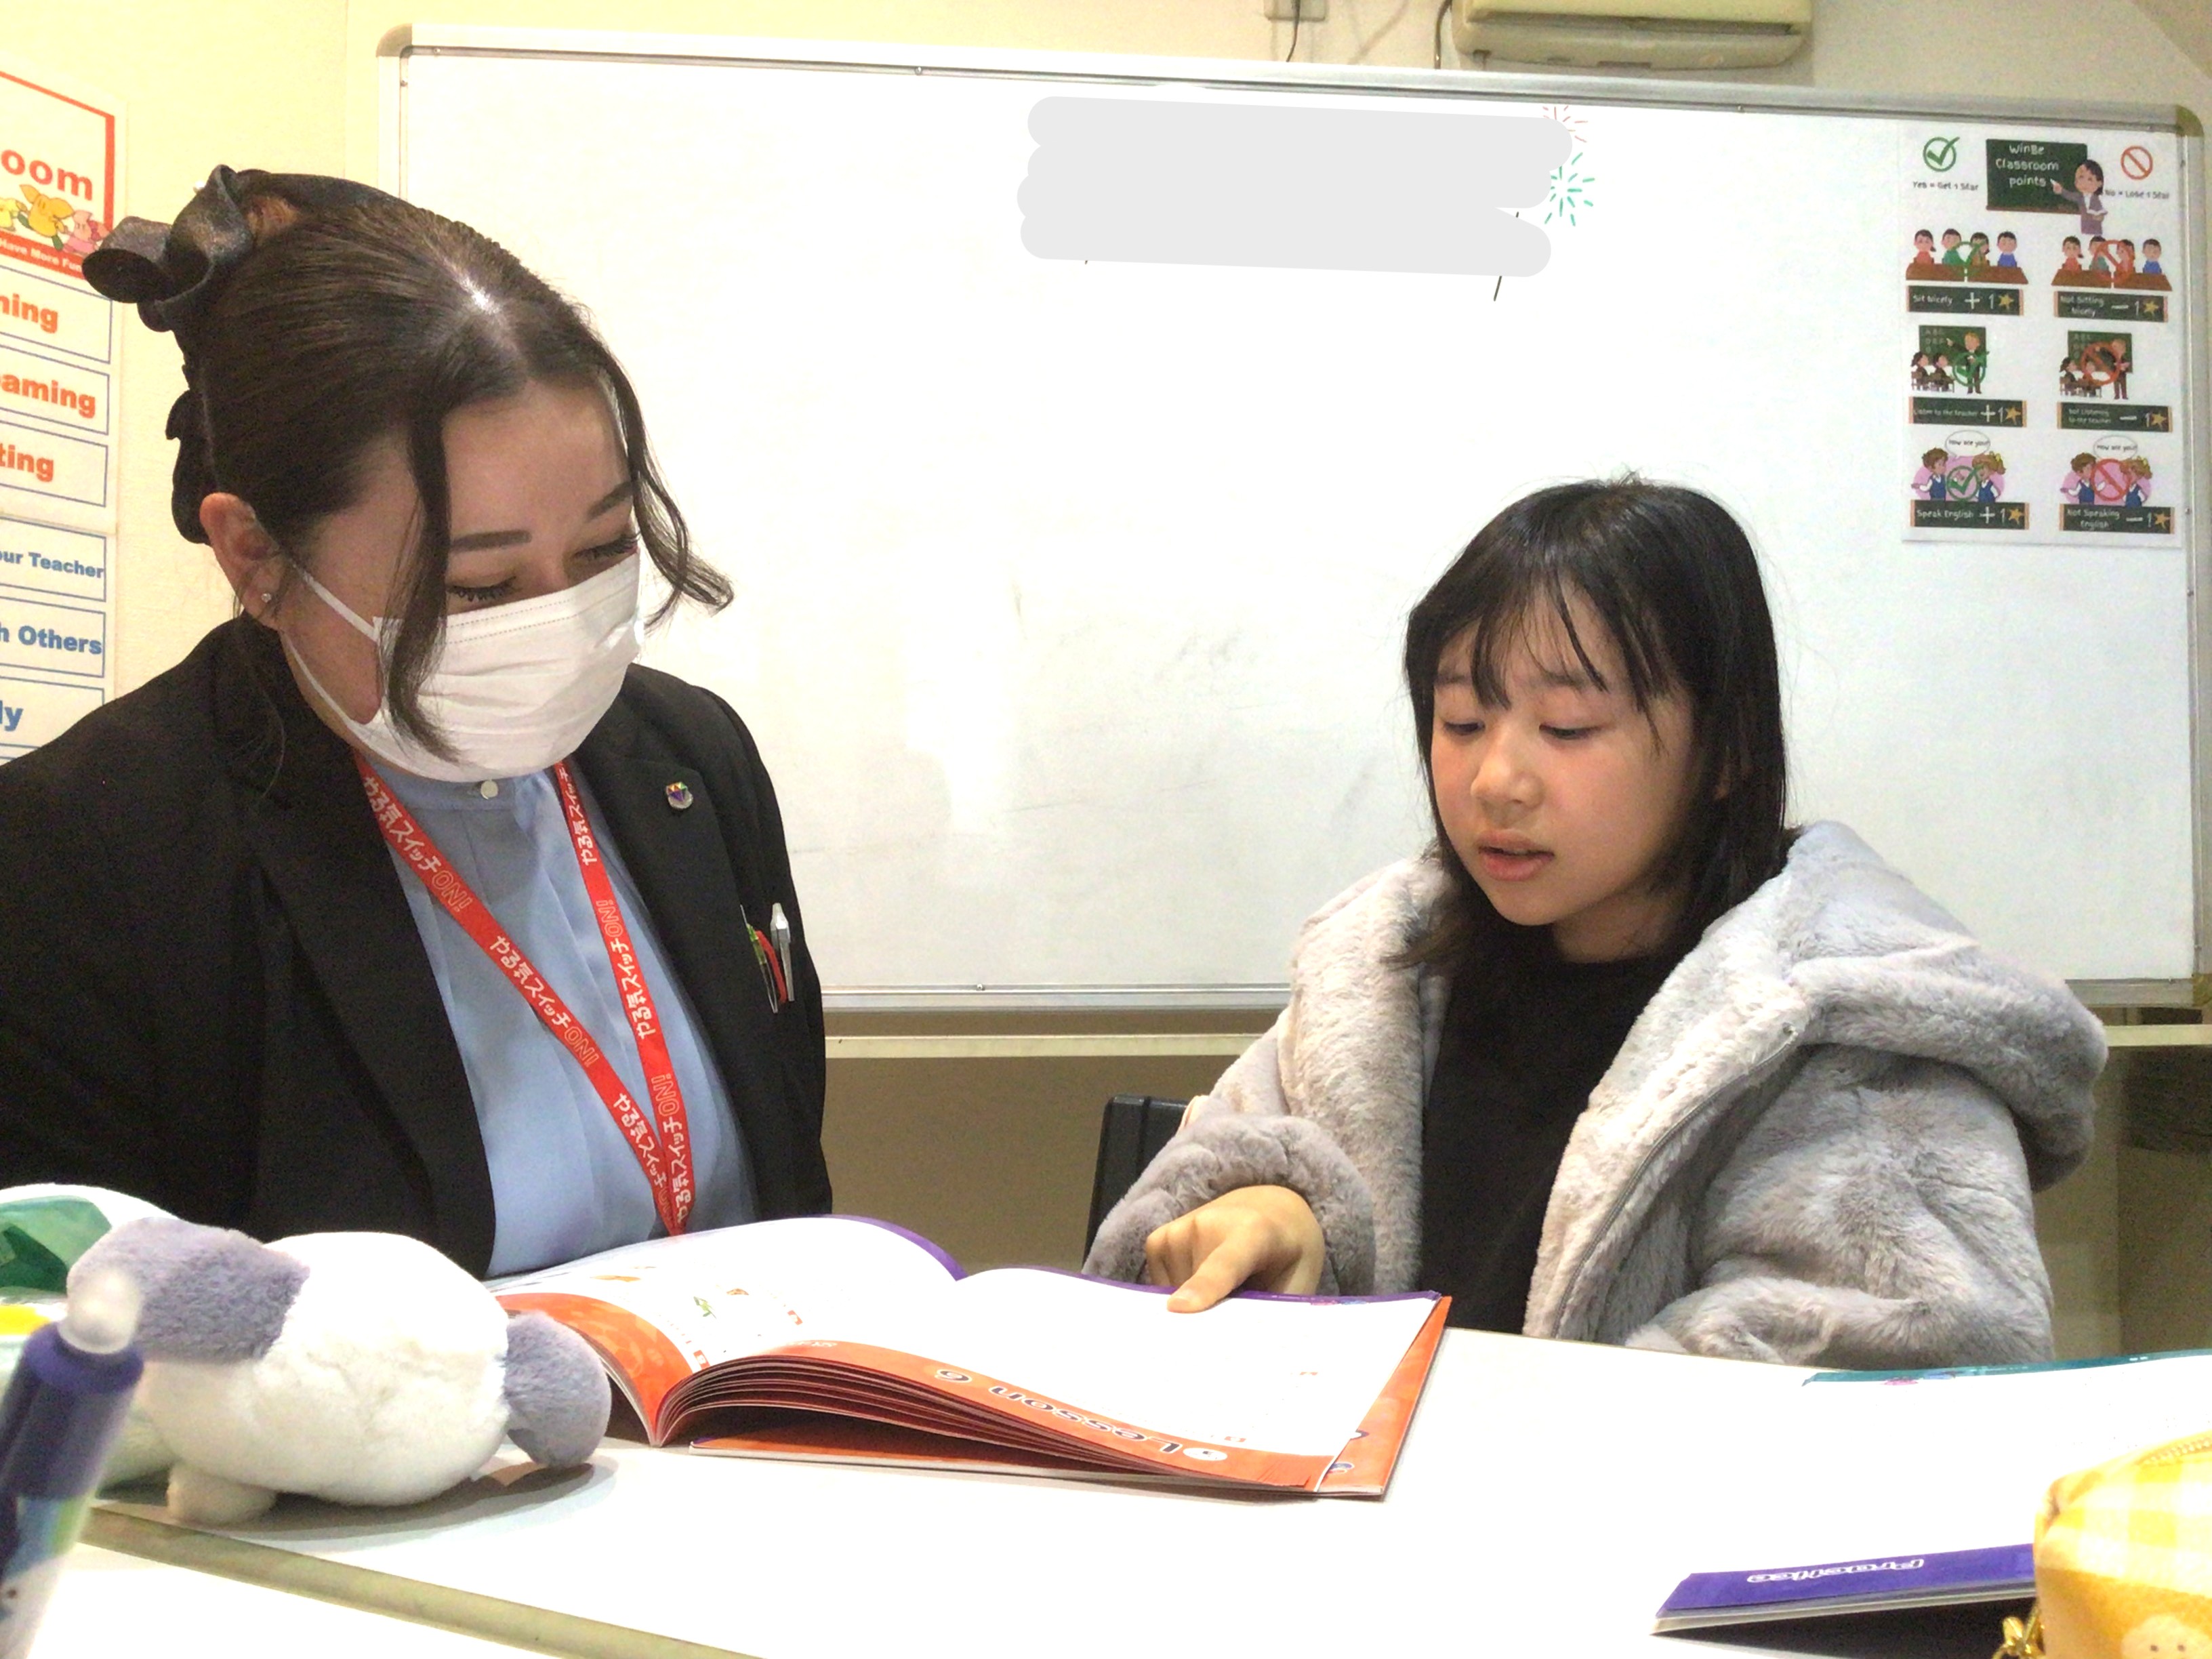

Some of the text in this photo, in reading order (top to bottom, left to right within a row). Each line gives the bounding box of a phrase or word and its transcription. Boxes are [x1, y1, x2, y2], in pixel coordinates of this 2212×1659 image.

[2009, 144, 2045, 155] WinBe
[1996, 158, 2059, 171] Classroom
[1, 149, 93, 201] oom
[1912, 181, 1928, 189] Yes
[2009, 174, 2047, 188] points
[28, 552, 104, 579] Teacher
[18, 625, 102, 655] Others
[988, 1378, 1183, 1454] Lesson
